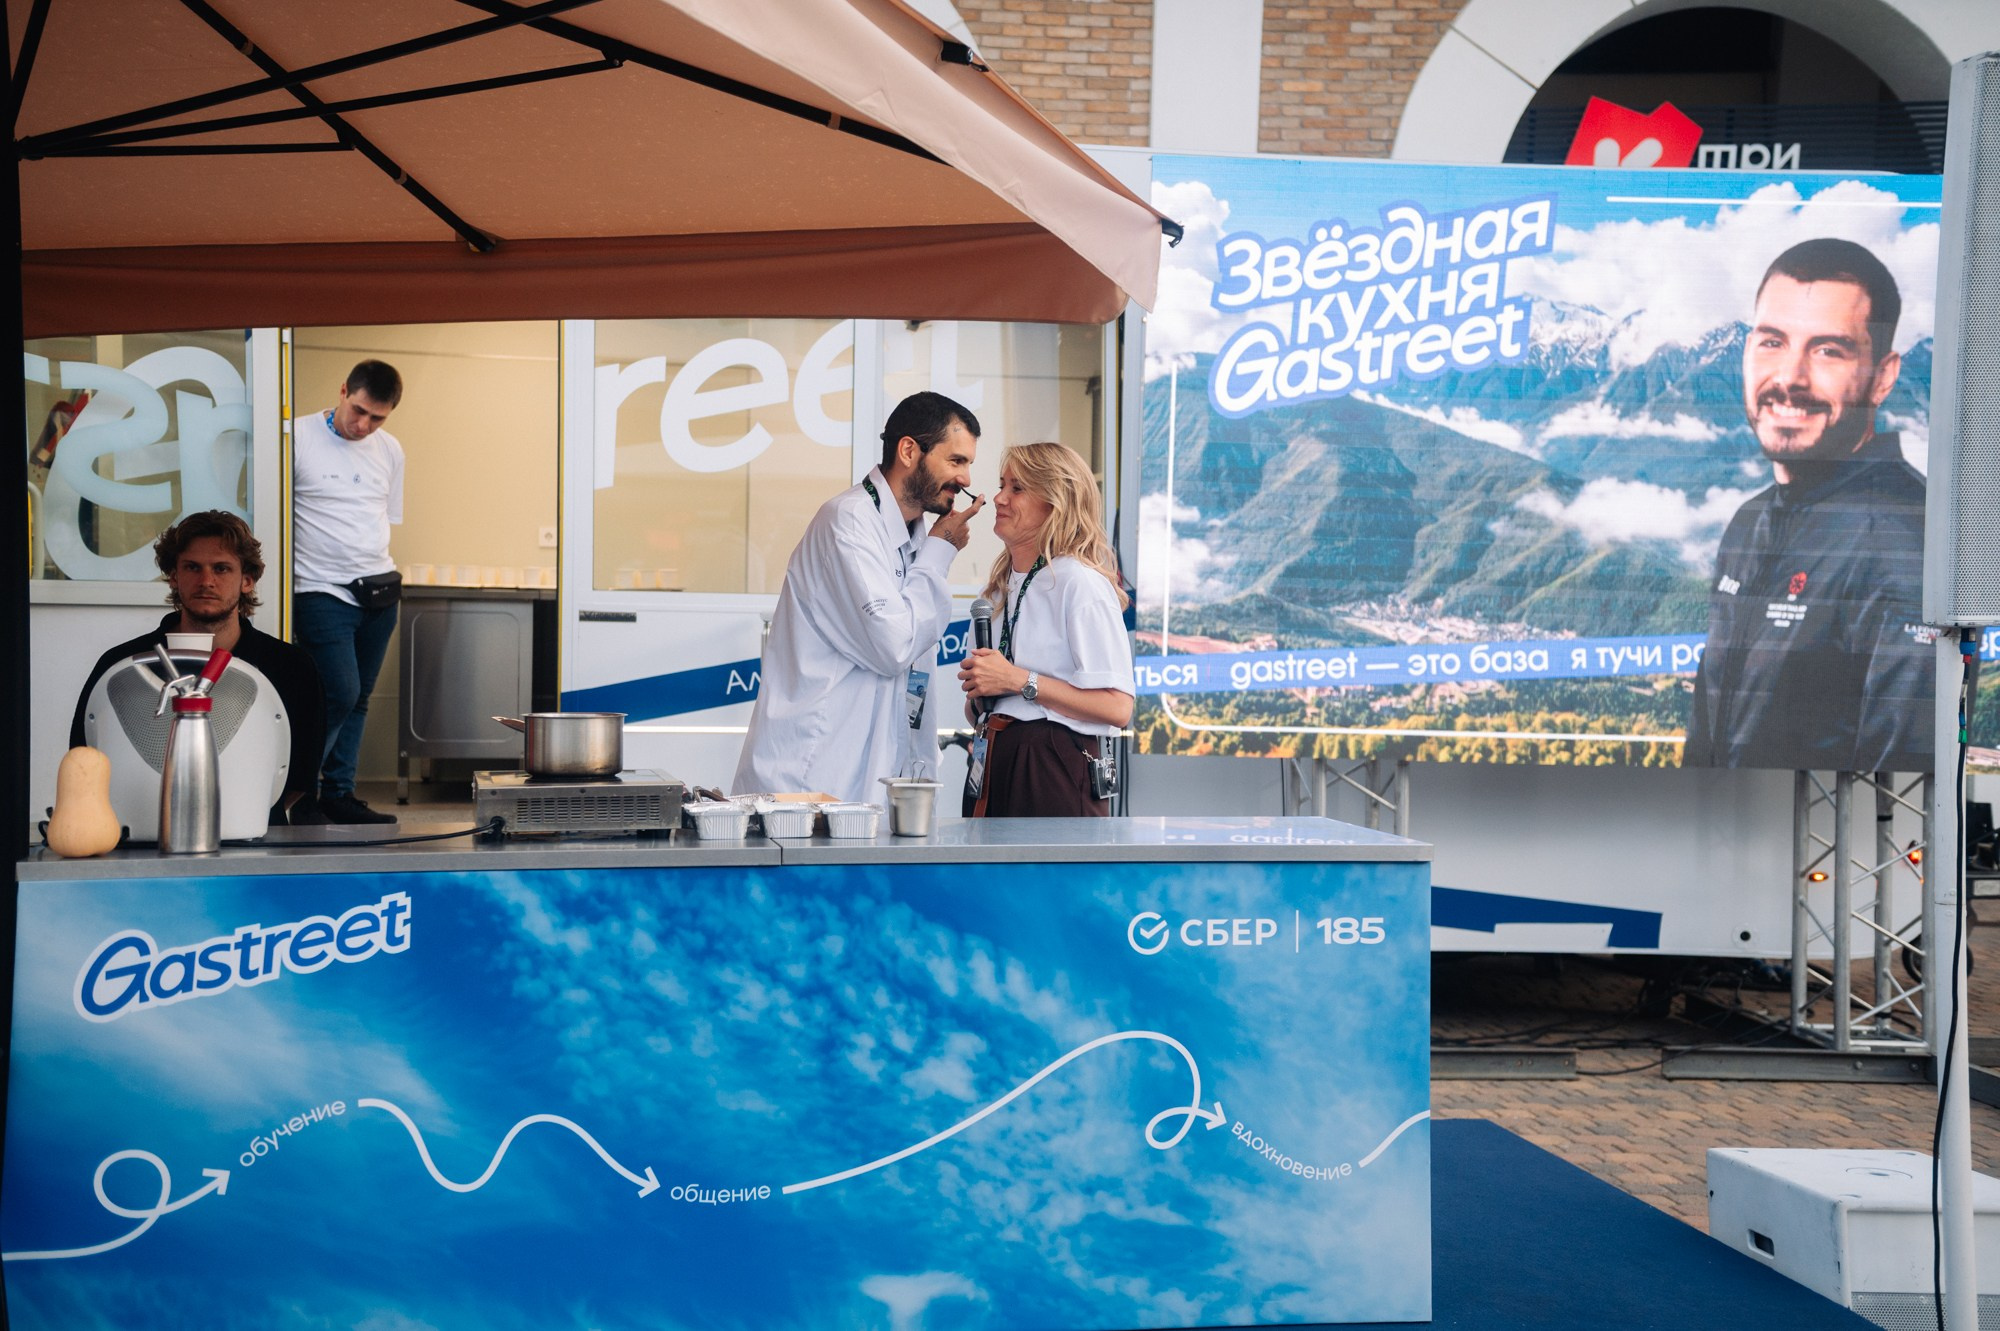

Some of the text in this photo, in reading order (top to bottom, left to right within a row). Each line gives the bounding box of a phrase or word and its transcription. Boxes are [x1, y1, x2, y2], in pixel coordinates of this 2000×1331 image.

[1217, 199, 1551, 306] Звёздная
[1297, 262, 1500, 348] кухня
[1214, 304, 1524, 412] Gastreet
[1230, 651, 1359, 690] gastreet
[1407, 653, 1461, 676] это
[1469, 644, 1549, 673] база
[1571, 647, 1587, 670] я
[1595, 644, 1662, 674] тучи
[79, 898, 408, 1018] Gastreet
[1179, 916, 1386, 947] СБЕР 185
[239, 1100, 346, 1167] обучение
[1231, 1121, 1353, 1181] вдохновение
[670, 1183, 771, 1206] общение
